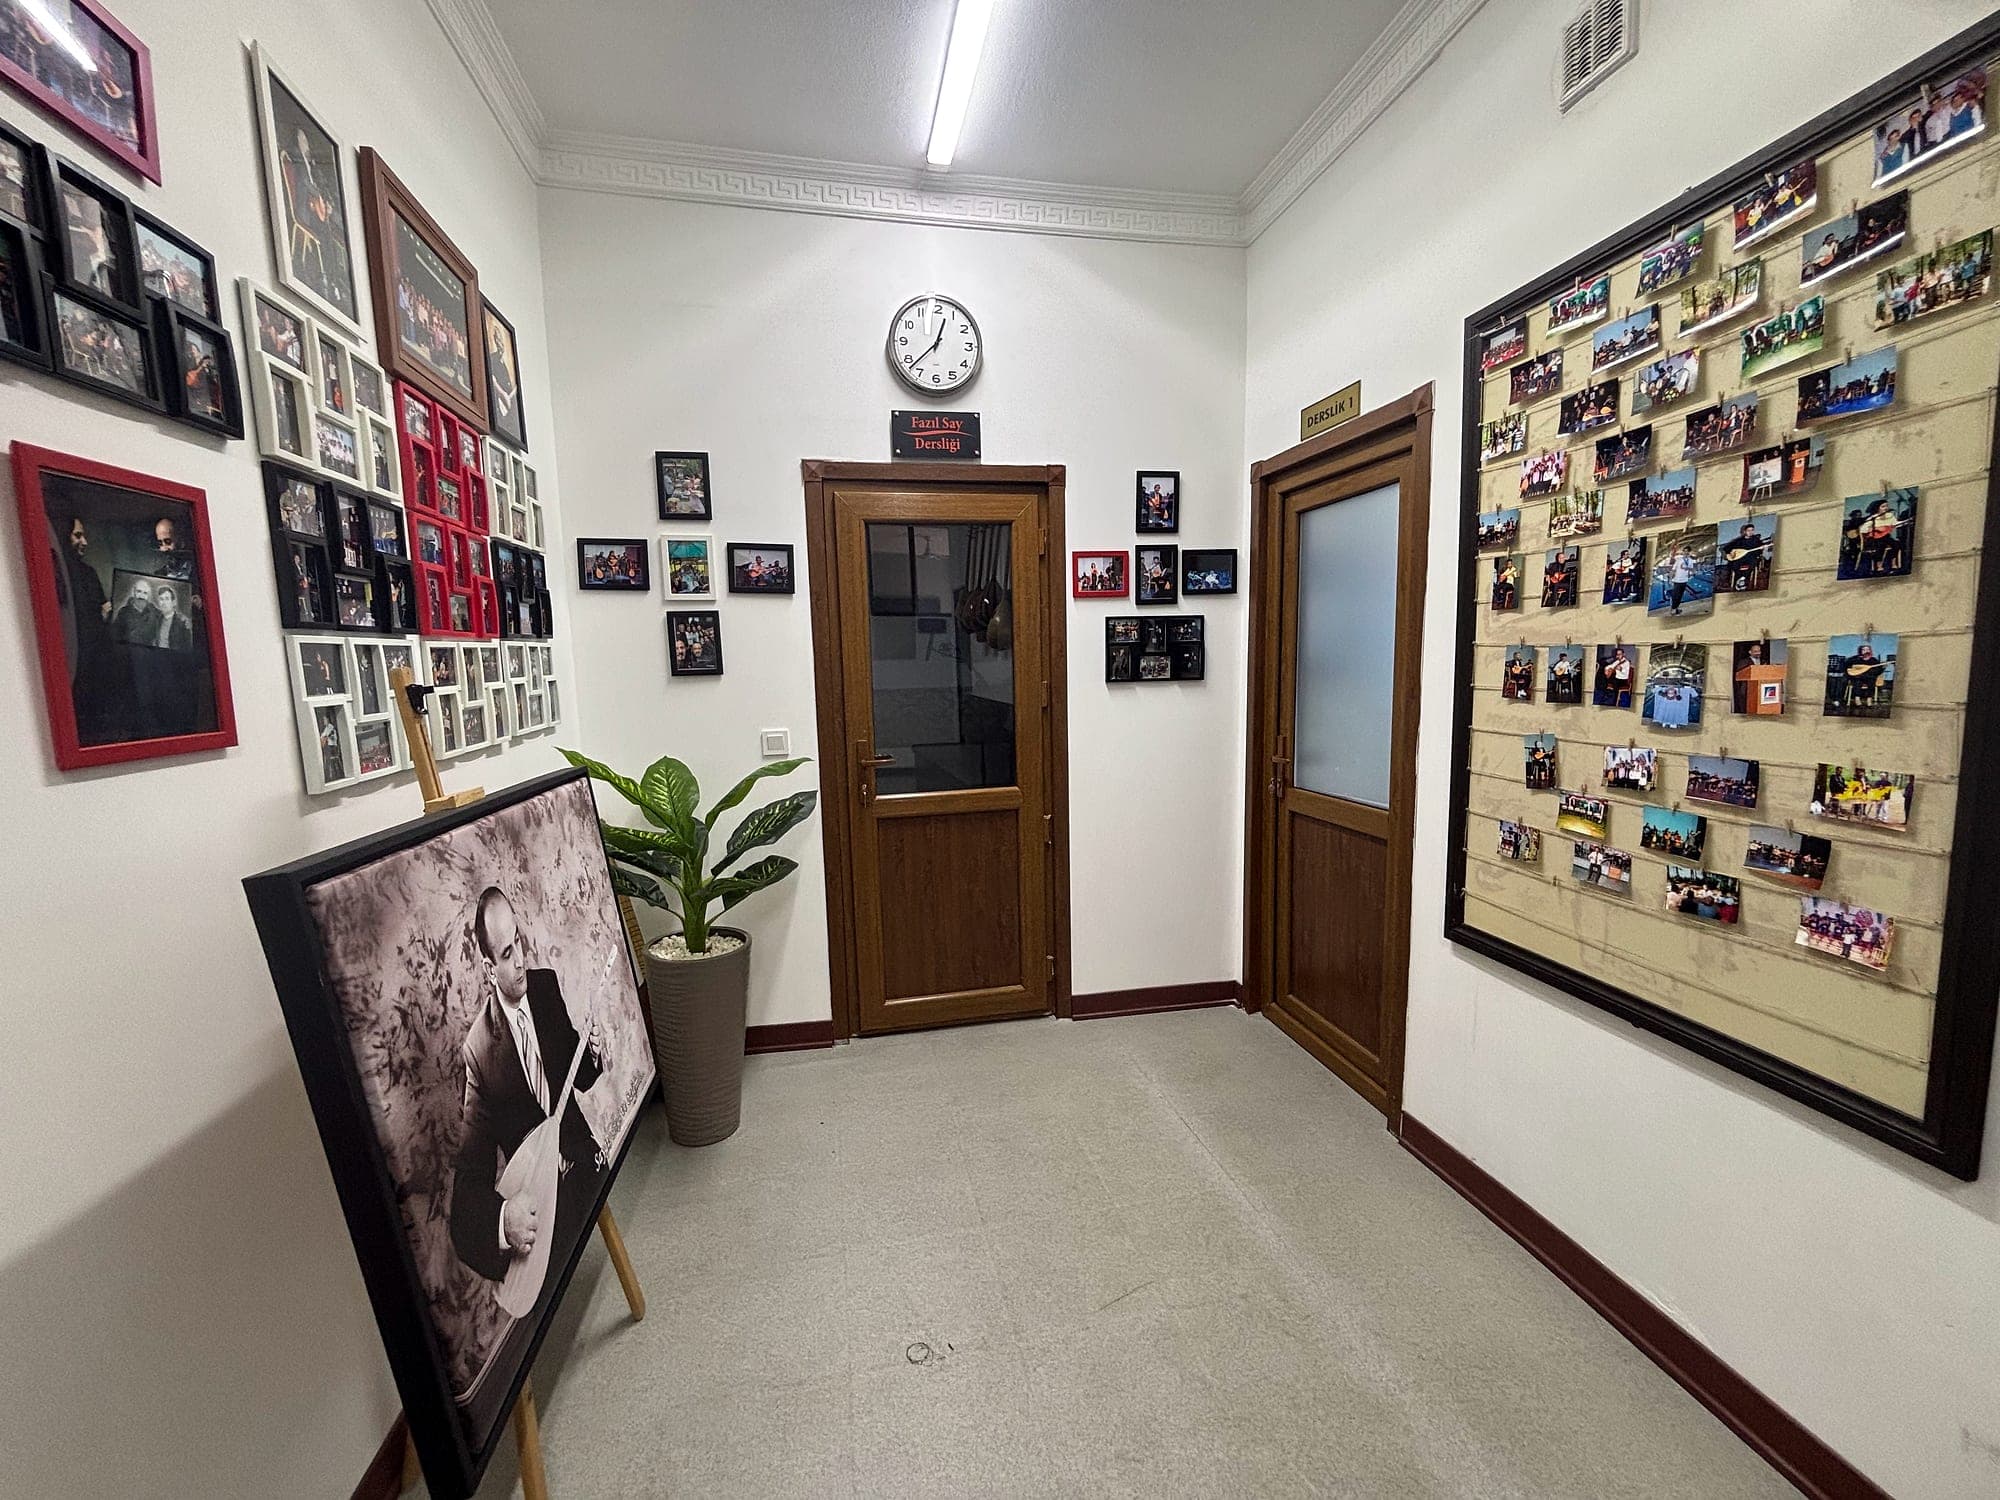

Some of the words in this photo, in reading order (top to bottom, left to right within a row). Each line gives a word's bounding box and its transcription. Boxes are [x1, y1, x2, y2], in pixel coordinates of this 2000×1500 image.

[917, 307, 925, 318] 11
[904, 319, 914, 330] 10
[959, 324, 969, 335] 2
[899, 336, 909, 346] 9
[963, 342, 974, 352] 3
[903, 354, 914, 364] 8
[959, 359, 969, 369] 4
[915, 367, 924, 378] 7
[947, 370, 958, 381] 5
[931, 374, 941, 384] 6
[1307, 400, 1345, 428] DERSLİK
[1349, 396, 1353, 408] 1
[911, 416, 939, 429] Fazıl
[942, 416, 964, 432] Say
[915, 437, 961, 454] Dersliği
